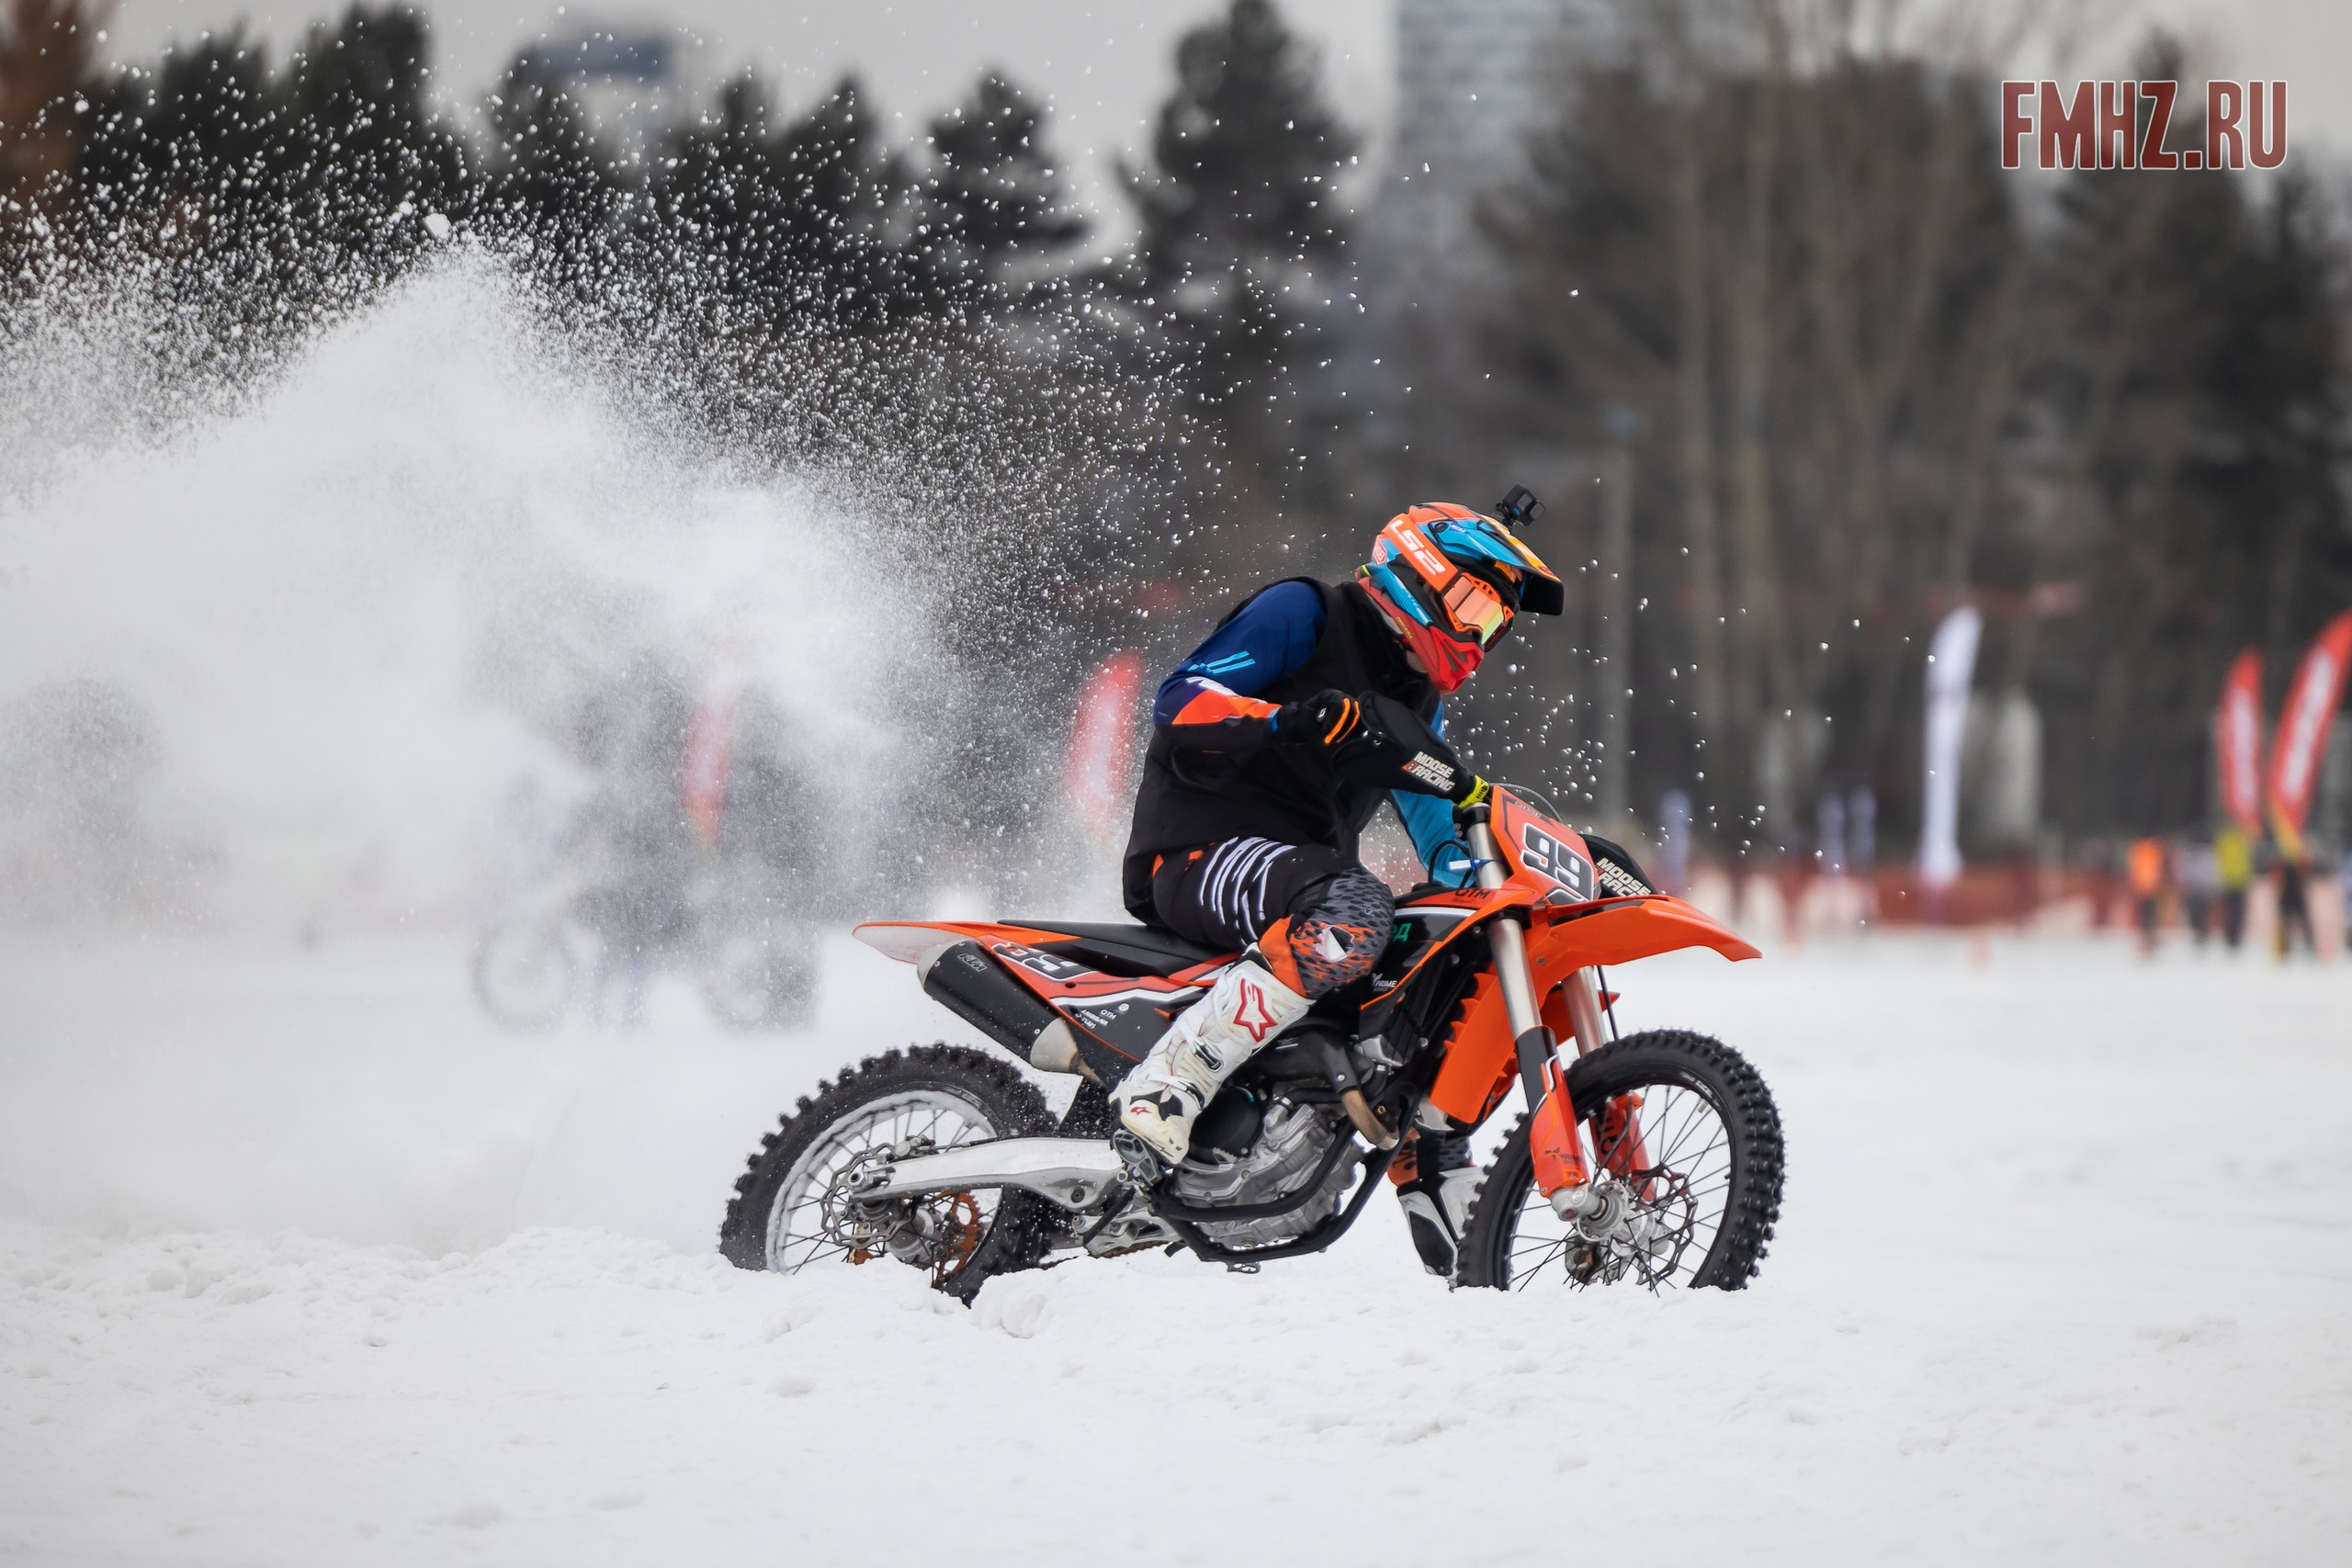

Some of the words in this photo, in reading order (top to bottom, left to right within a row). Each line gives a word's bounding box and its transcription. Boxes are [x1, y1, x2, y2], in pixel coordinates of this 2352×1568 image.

[1389, 519, 1446, 575] LS2
[1410, 764, 1456, 791] RACING
[1413, 750, 1454, 778] MOOSE
[1521, 822, 1594, 901] 99
[1597, 857, 1651, 896] MOOSE
[1599, 873, 1639, 897] RAC
[957, 953, 988, 972] KTM
